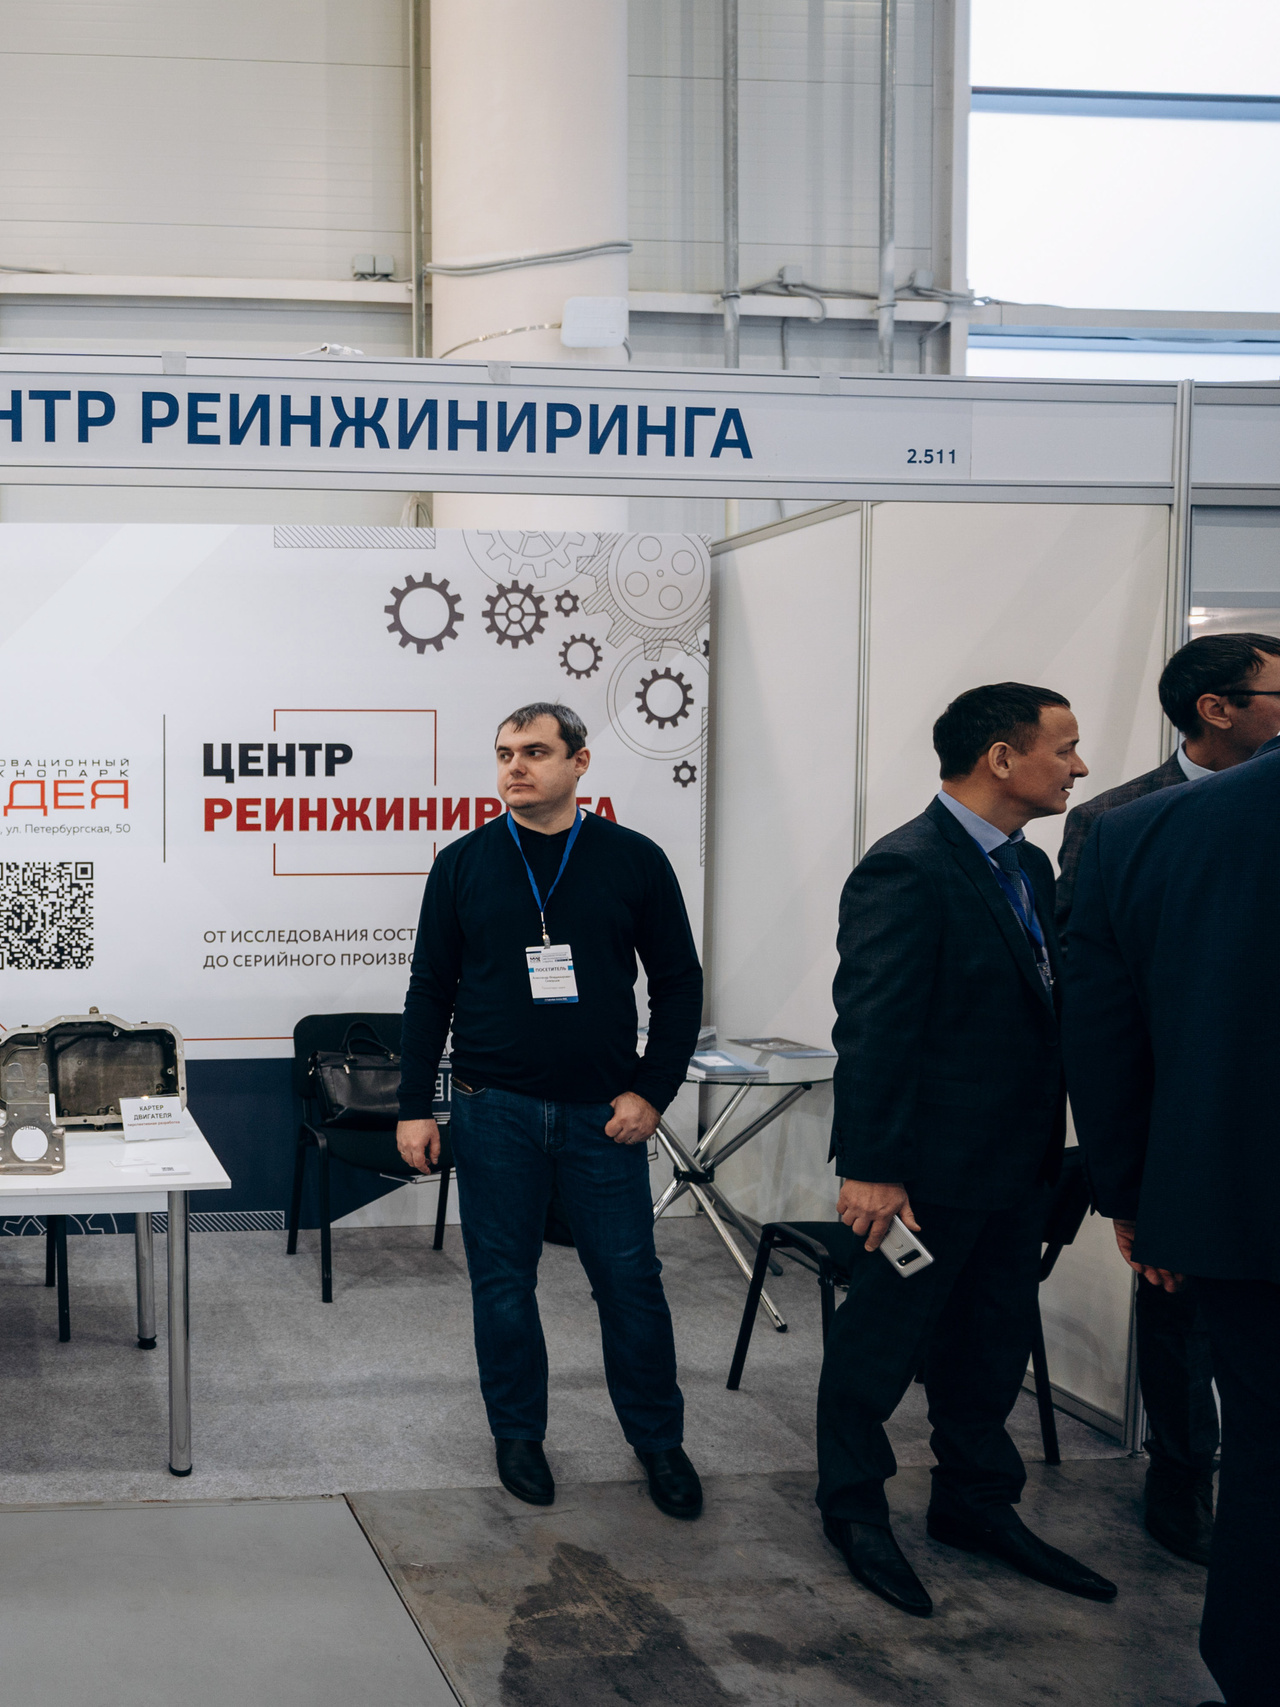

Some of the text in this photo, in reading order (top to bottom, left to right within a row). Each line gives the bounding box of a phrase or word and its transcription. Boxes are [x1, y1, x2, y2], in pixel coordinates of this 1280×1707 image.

[141, 391, 753, 459] РЕИНЖИНИРИНГА
[906, 448, 956, 464] 2.511
[202, 743, 353, 784] ЦЕНТР
[203, 797, 618, 832] РЕИНЖИНИРГА
[6, 827, 22, 836] ул.
[25, 823, 113, 836] Петербургская,
[115, 823, 131, 834] 50
[203, 930, 227, 943] ОТ
[231, 929, 368, 944] ИССЛЕДОВАНИЯ
[203, 955, 229, 969] ДО
[233, 951, 336, 968] СЕРИЙНОГО
[133, 1112, 173, 1121] ДВИГАТЕЛЯ
